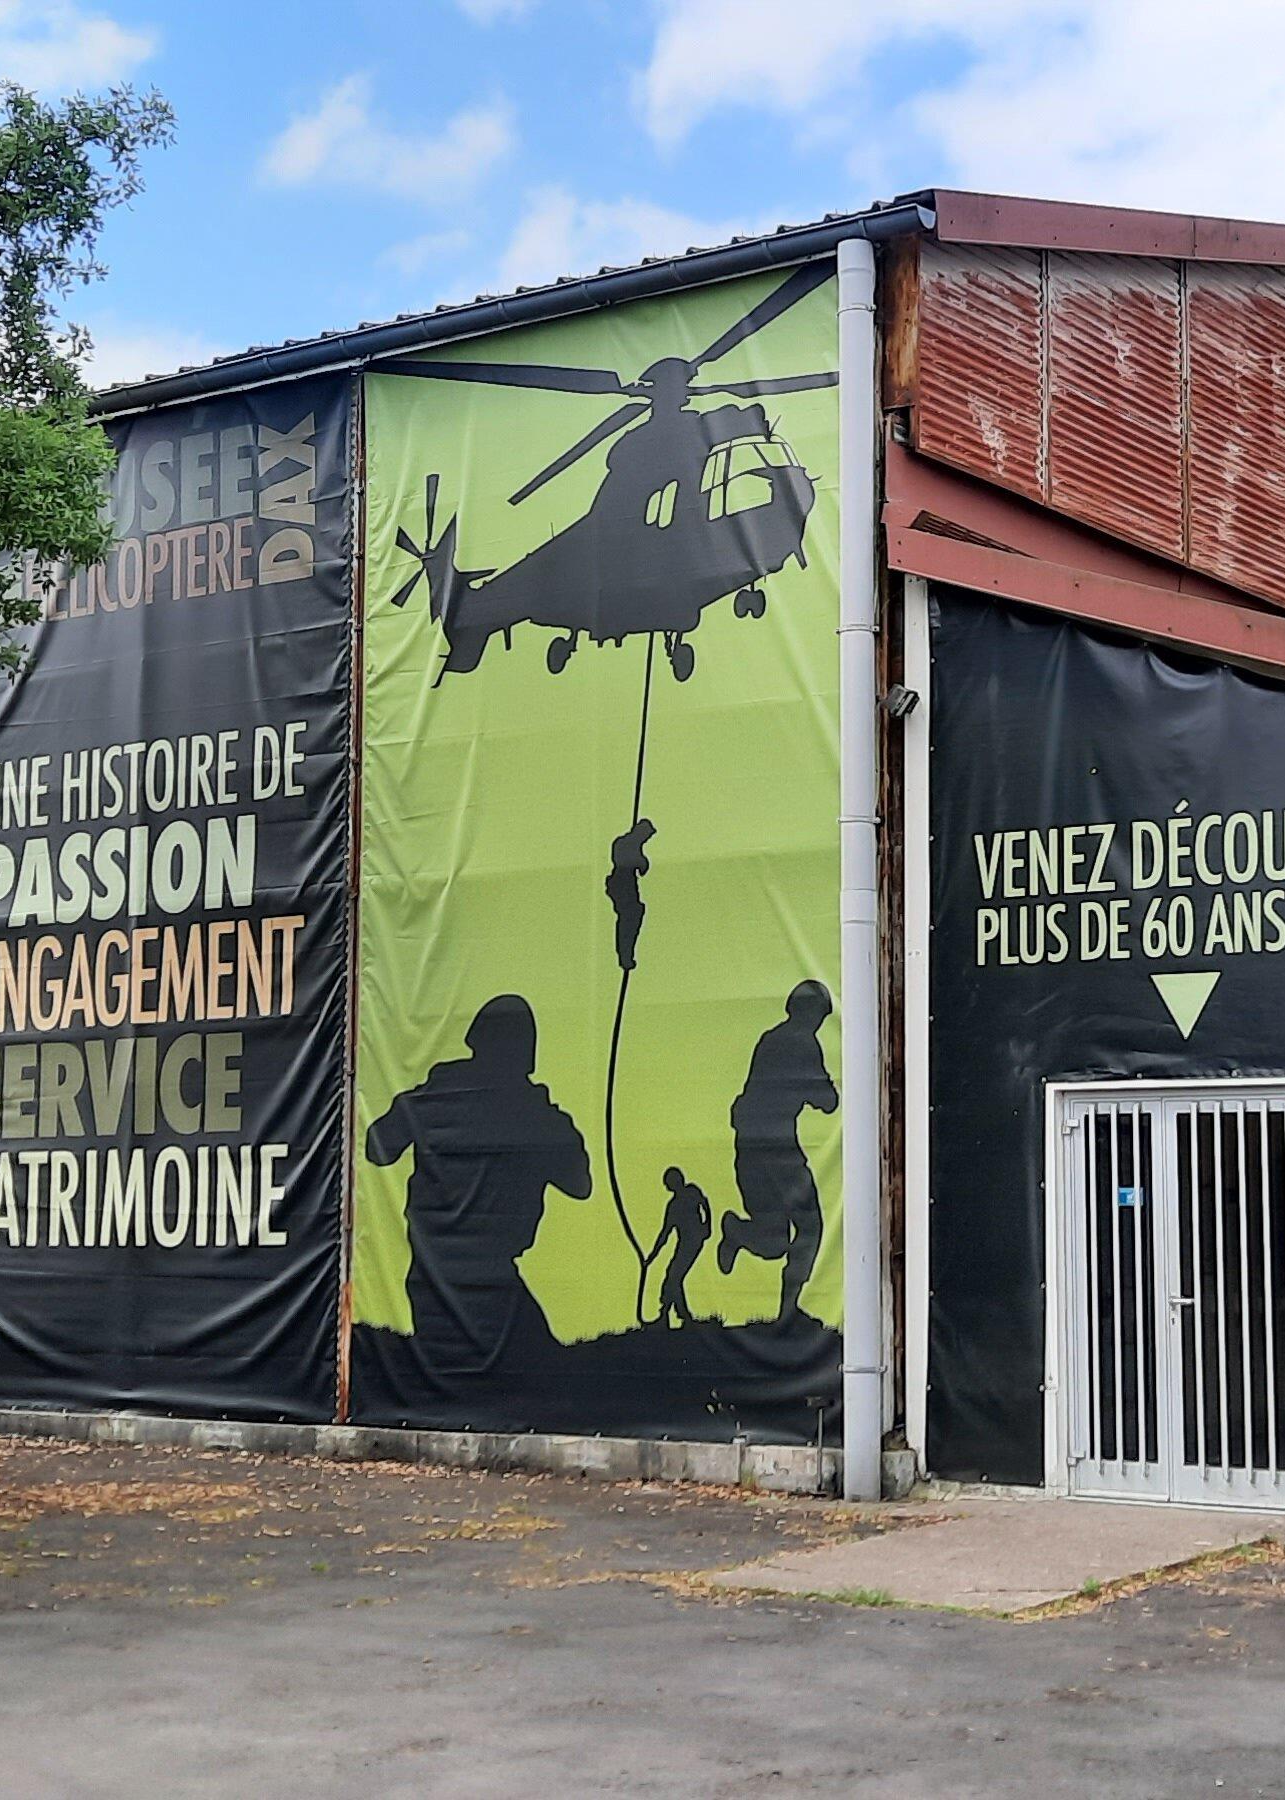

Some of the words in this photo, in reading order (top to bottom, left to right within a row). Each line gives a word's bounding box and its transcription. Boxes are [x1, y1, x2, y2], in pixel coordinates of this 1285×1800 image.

[257, 411, 316, 586] DAX
[61, 730, 241, 824] HISTOIRE
[253, 721, 308, 800] DE
[974, 822, 1116, 899] VENEZ
[976, 904, 1069, 966] PLUS
[1080, 899, 1130, 961] DE
[1142, 896, 1193, 958] 60
